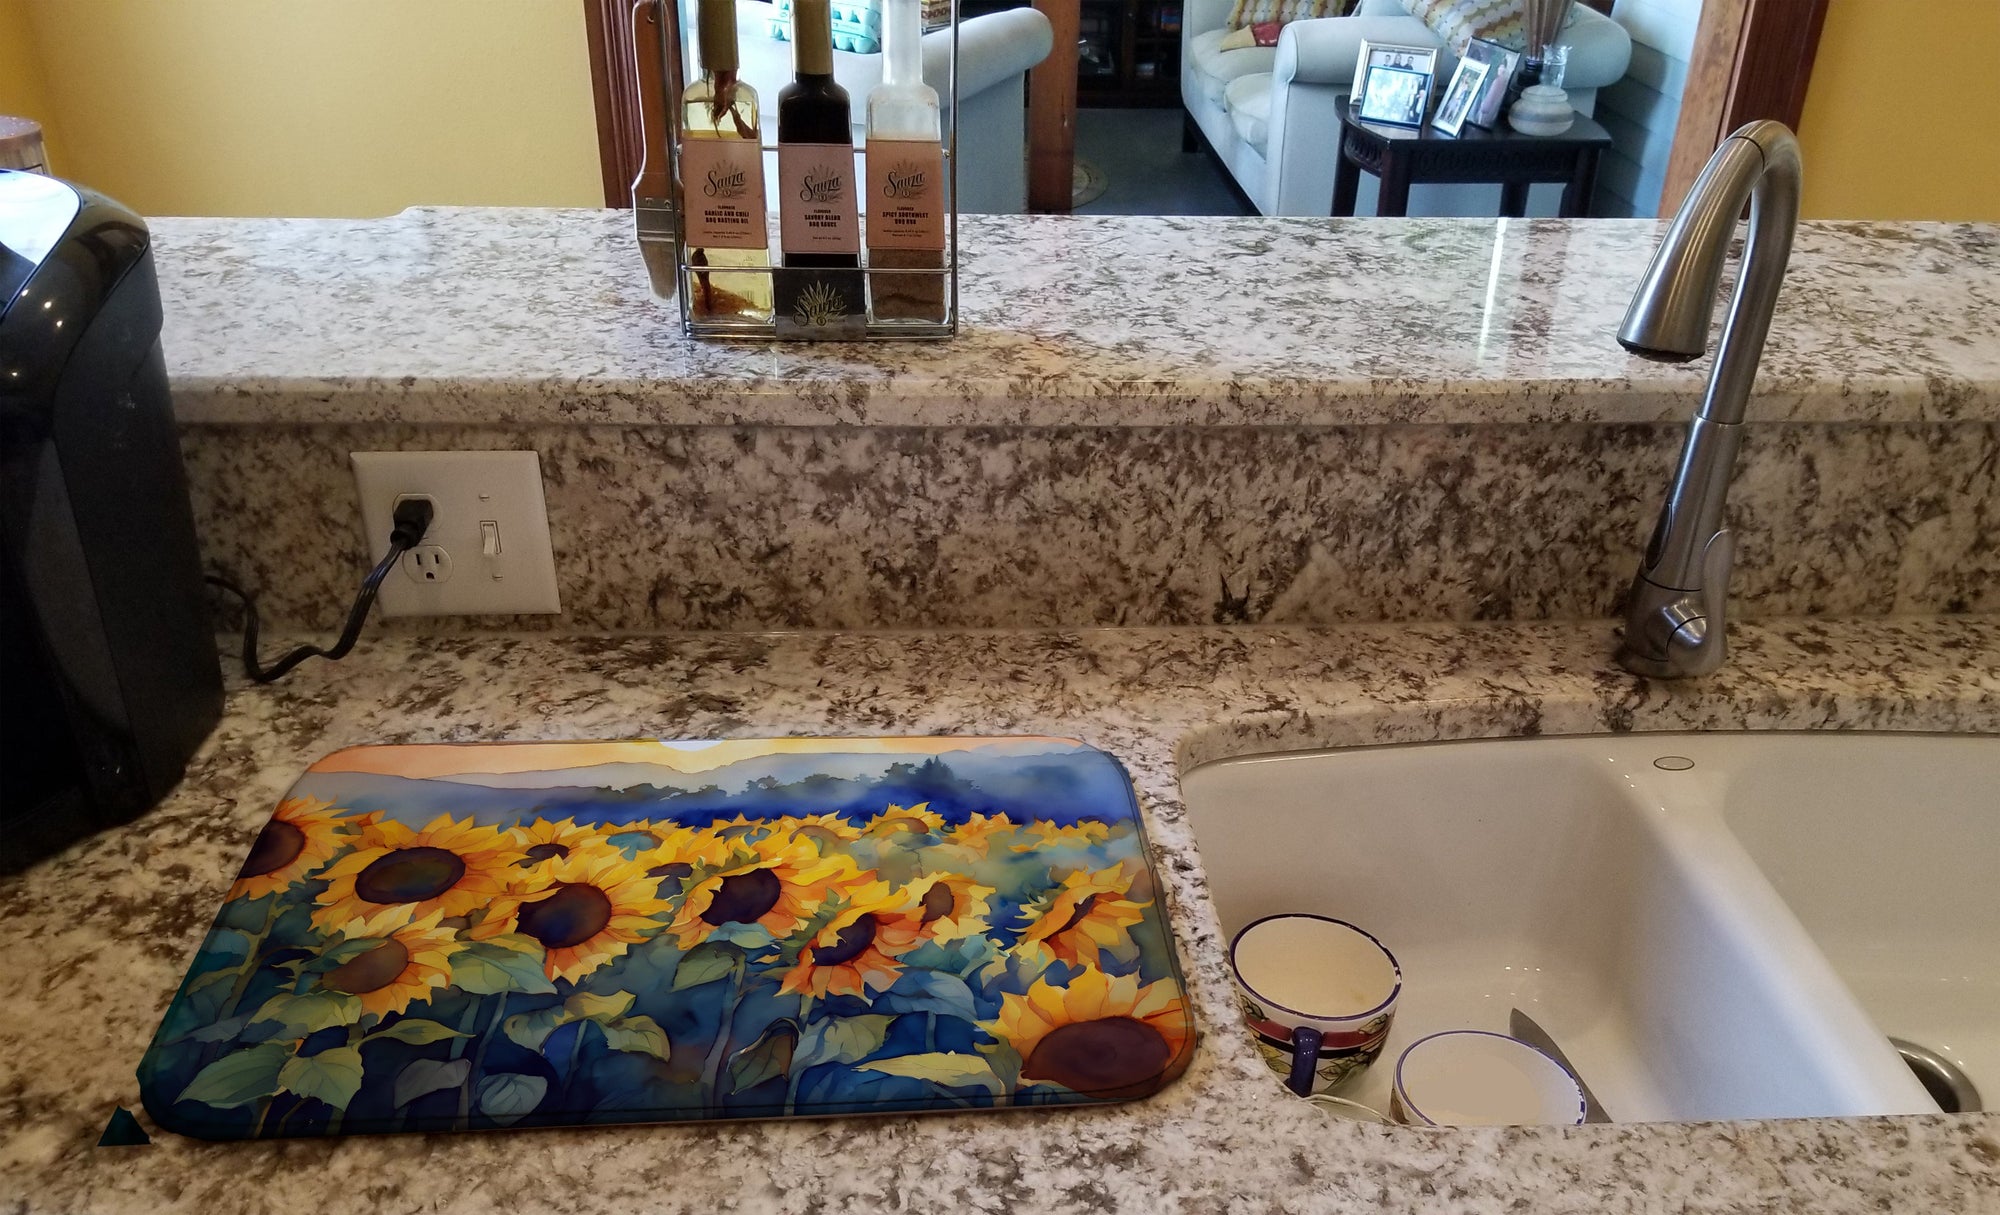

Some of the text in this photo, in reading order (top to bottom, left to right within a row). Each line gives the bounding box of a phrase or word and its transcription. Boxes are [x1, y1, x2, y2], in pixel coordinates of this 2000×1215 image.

[704, 170, 745, 197] Sauza
[800, 175, 842, 202] Sauza
[884, 171, 925, 198] Sauza
